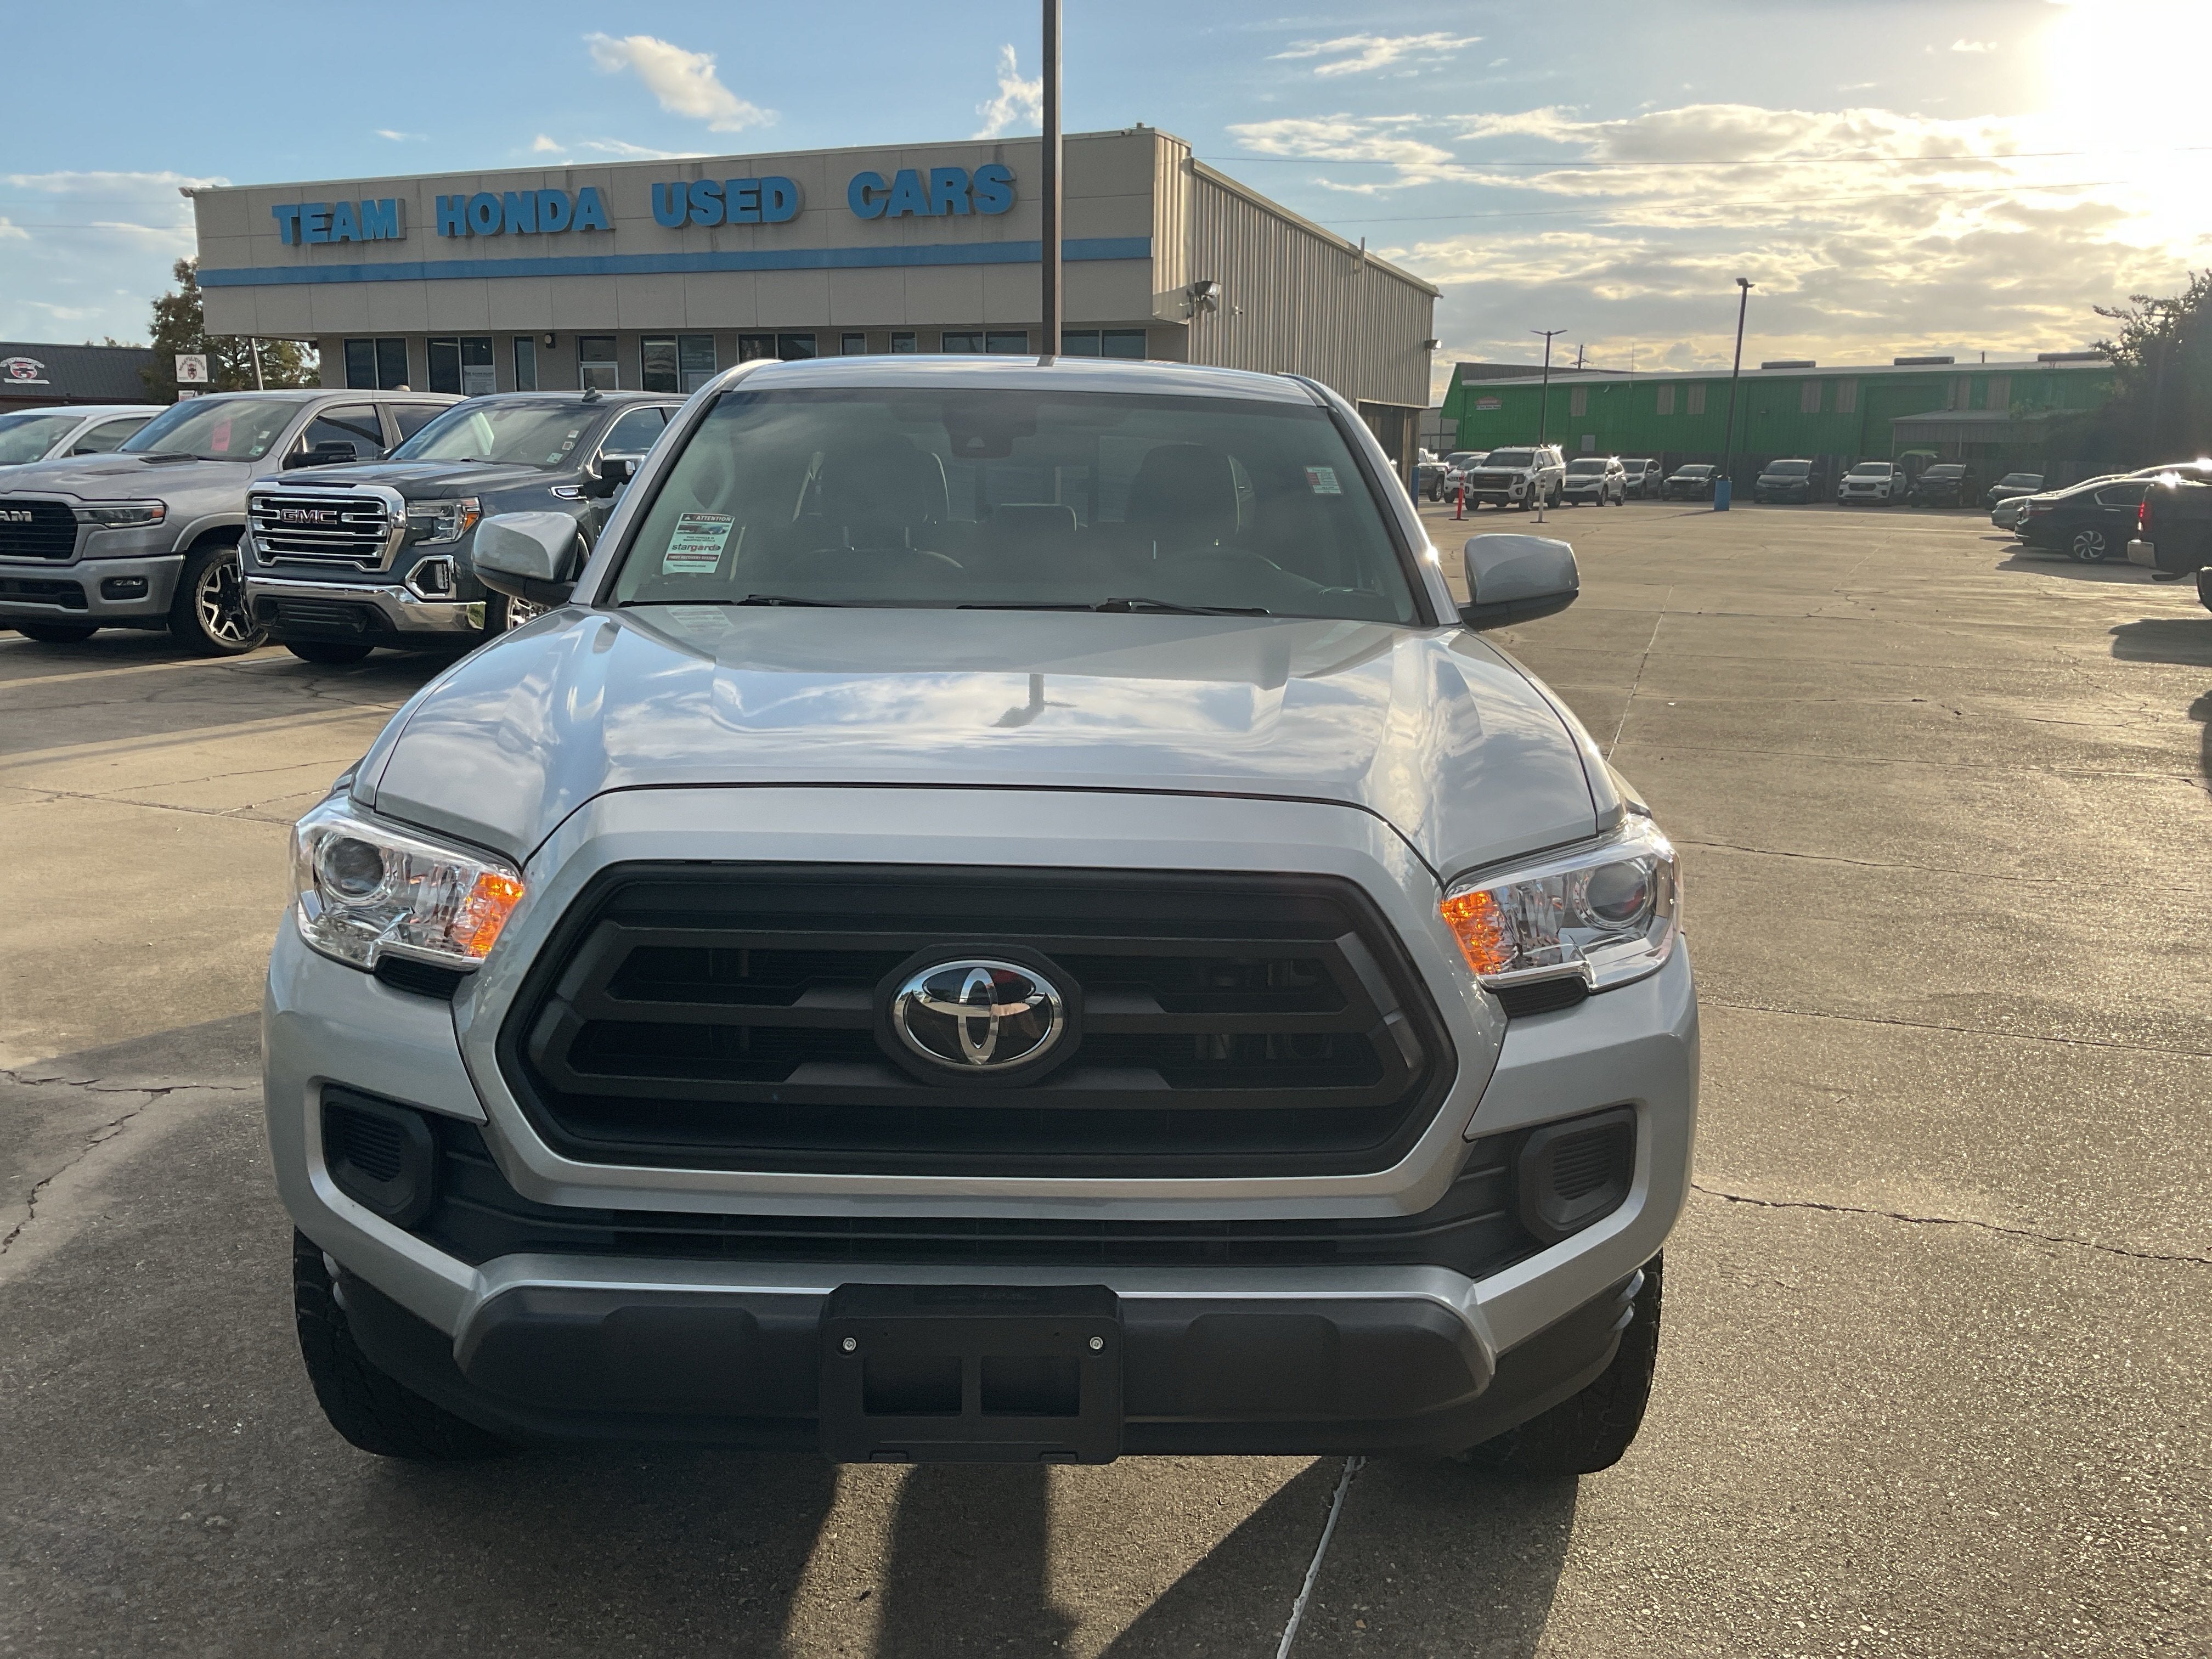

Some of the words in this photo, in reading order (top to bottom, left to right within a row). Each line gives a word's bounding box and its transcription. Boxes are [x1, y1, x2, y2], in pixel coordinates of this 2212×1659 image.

[272, 198, 404, 244] TEAM
[436, 187, 613, 236] HONDA
[651, 176, 803, 228] USED
[847, 164, 1015, 219] CARS
[0, 510, 32, 522] AM
[281, 509, 337, 525] GMC
[672, 544, 716, 552] stargard
